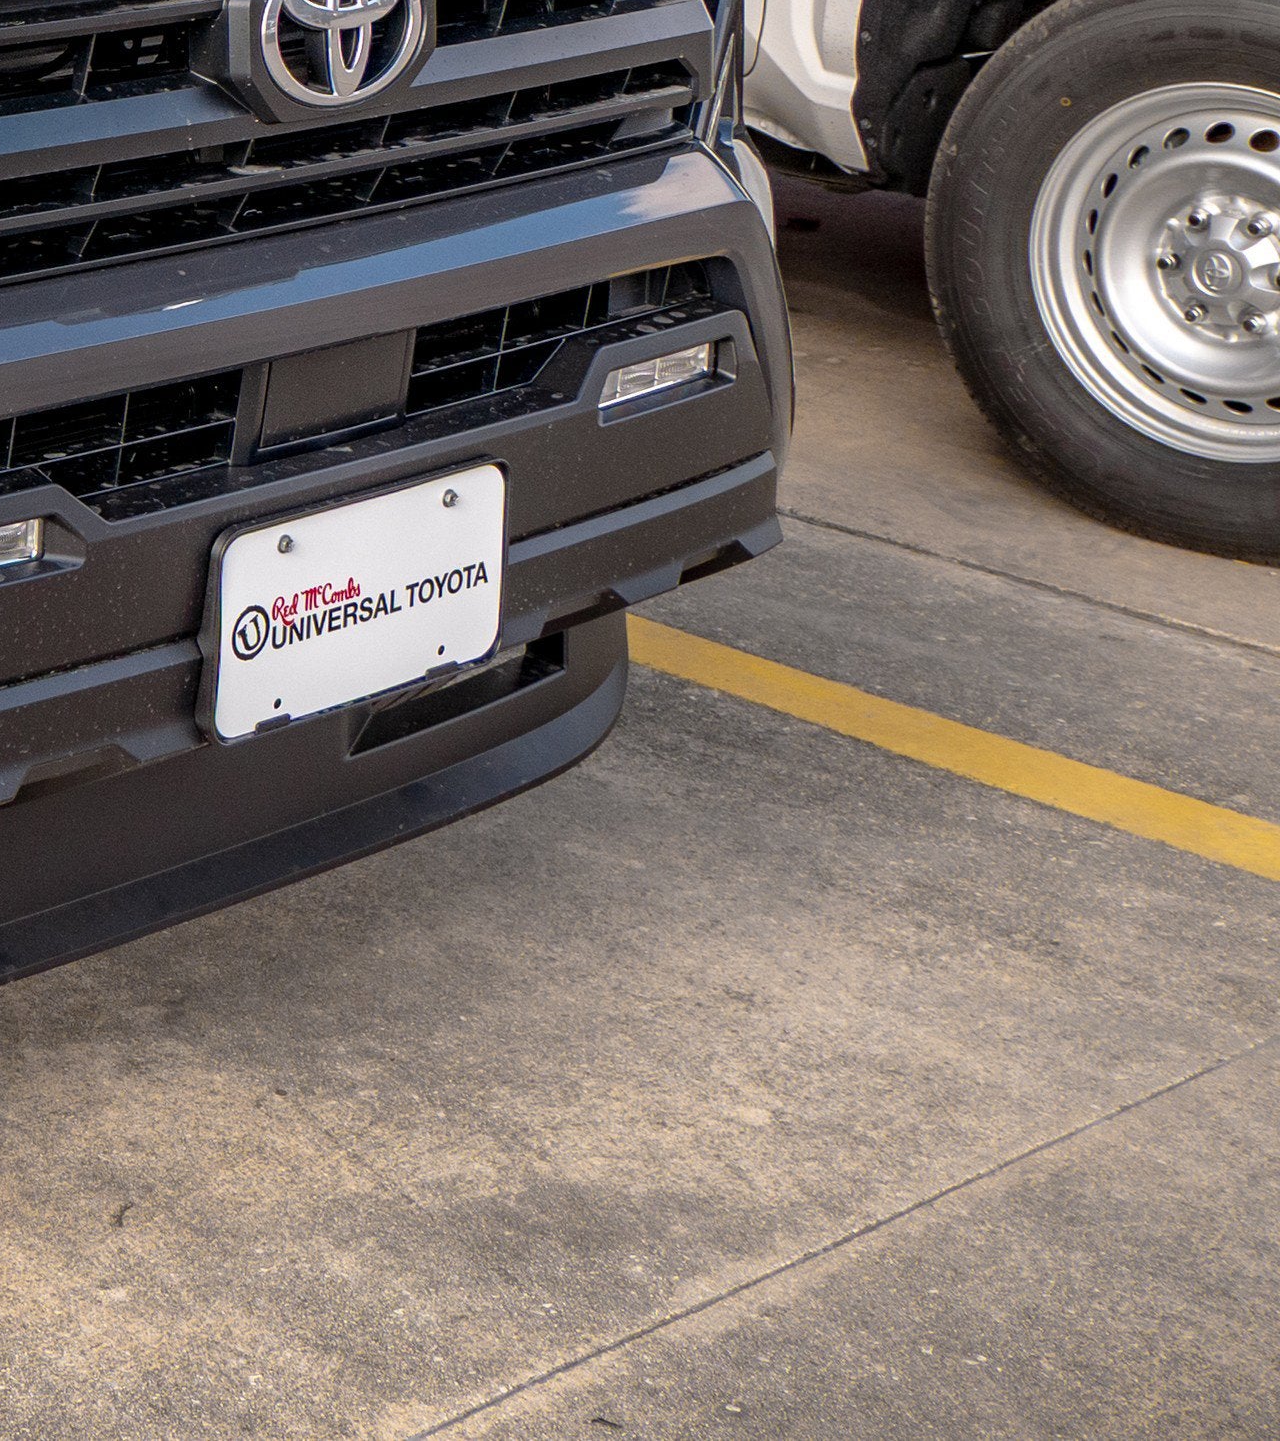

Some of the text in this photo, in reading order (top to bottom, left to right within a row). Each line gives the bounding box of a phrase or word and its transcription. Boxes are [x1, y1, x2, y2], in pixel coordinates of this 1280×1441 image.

[271, 576, 361, 626] Red McCombs
[271, 561, 489, 649] UNIVERSAL TOYOTA
